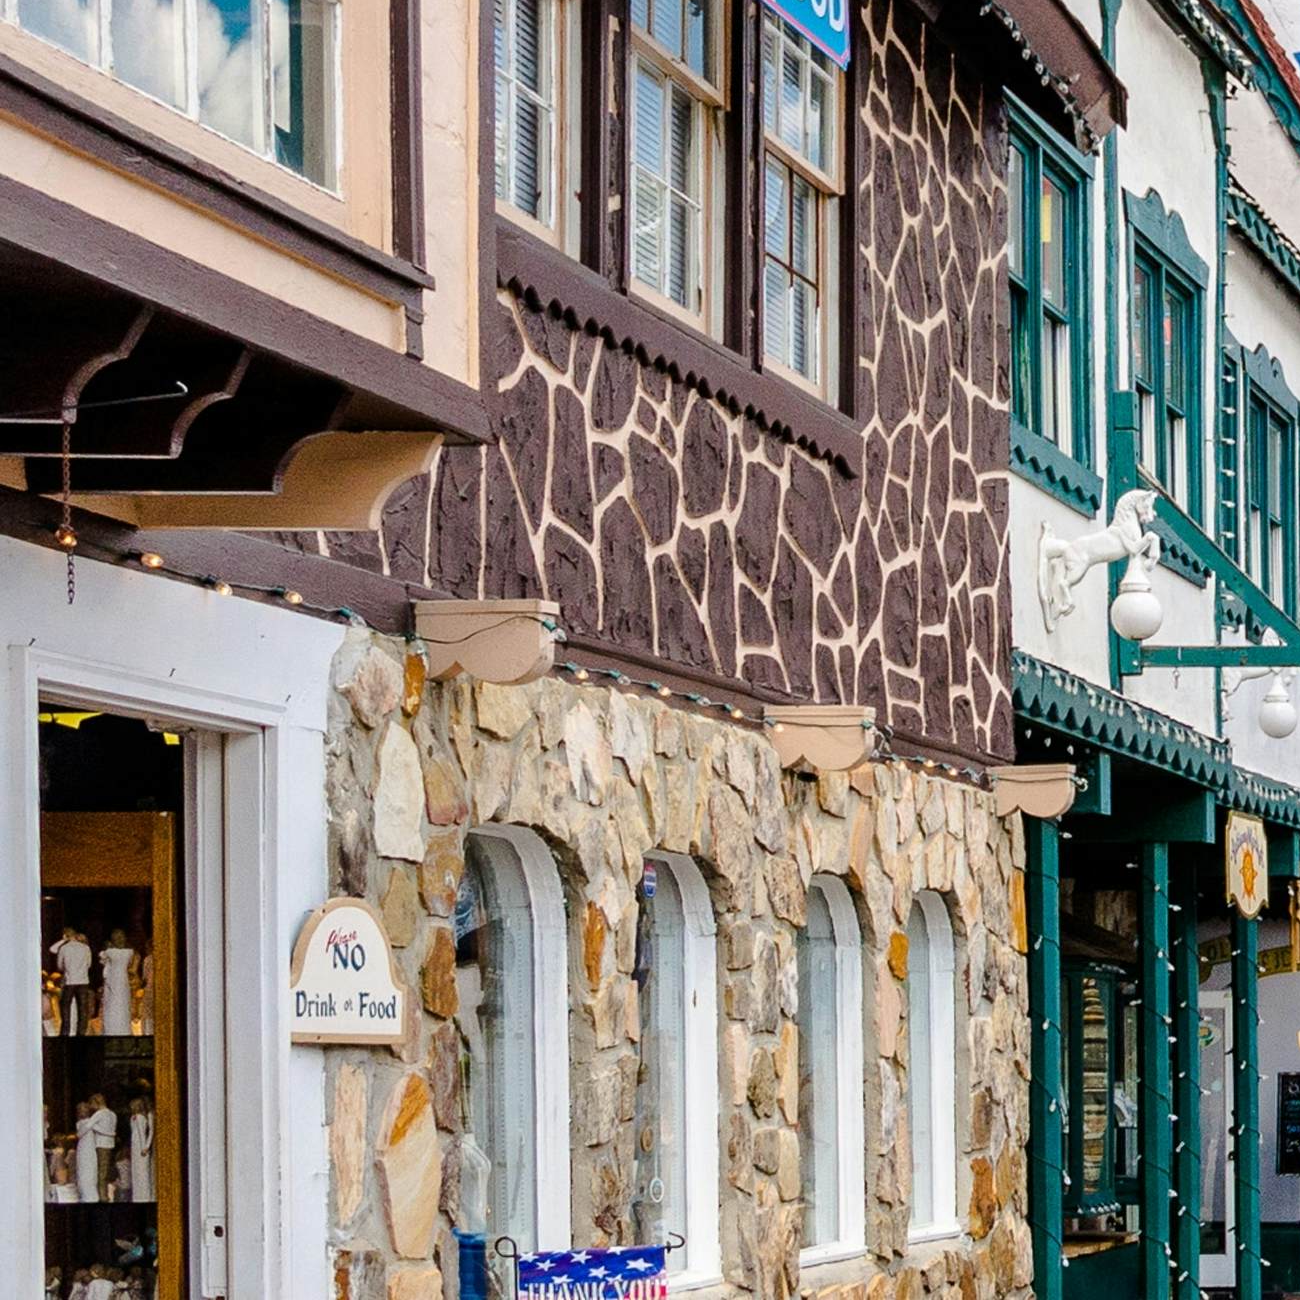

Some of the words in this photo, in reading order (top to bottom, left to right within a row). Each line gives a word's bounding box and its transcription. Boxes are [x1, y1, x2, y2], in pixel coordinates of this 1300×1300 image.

[333, 943, 366, 971] NO
[296, 990, 337, 1018] Drink
[359, 992, 397, 1019] Food
[525, 1282, 608, 1300] THANK
[613, 1279, 661, 1300] YOU
